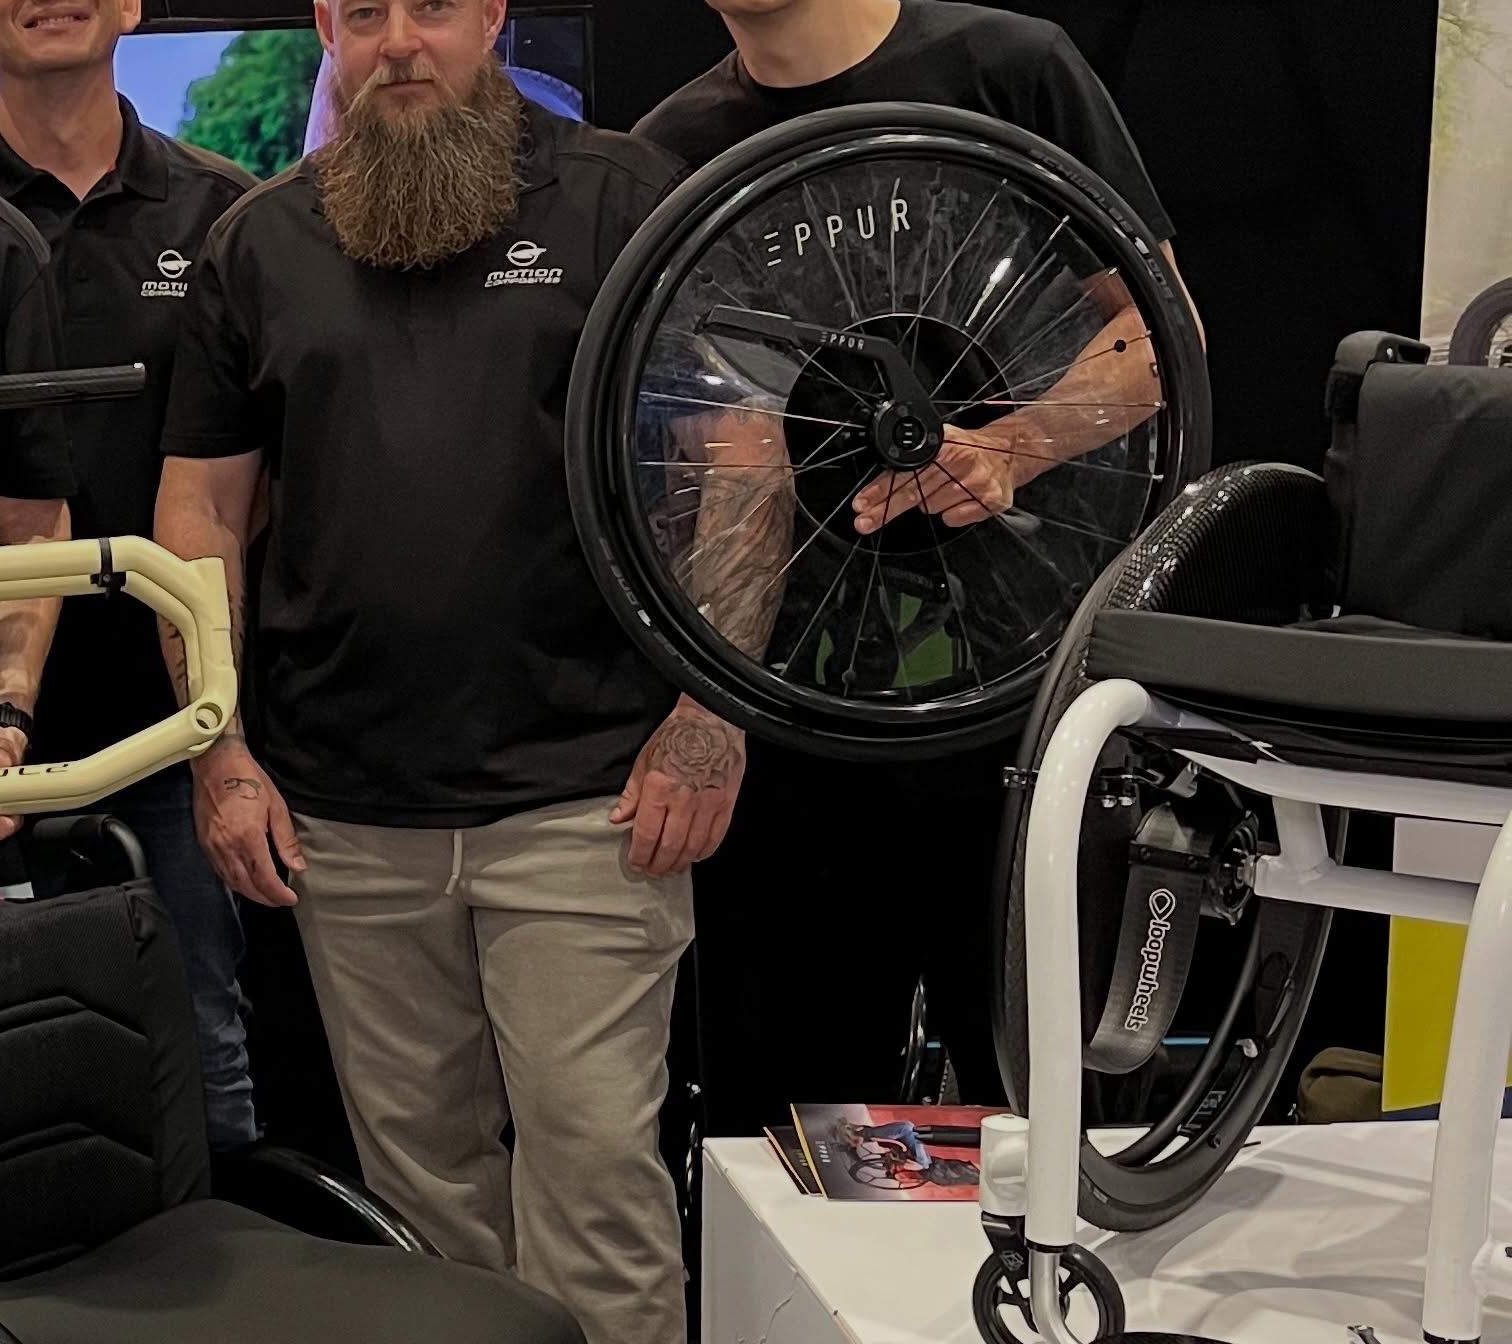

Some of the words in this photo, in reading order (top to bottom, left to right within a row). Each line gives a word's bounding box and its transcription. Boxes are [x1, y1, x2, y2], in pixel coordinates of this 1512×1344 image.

[763, 198, 911, 267] EPPUR
[141, 281, 188, 292] MOTI
[1125, 919, 1171, 1032] loopwheels
